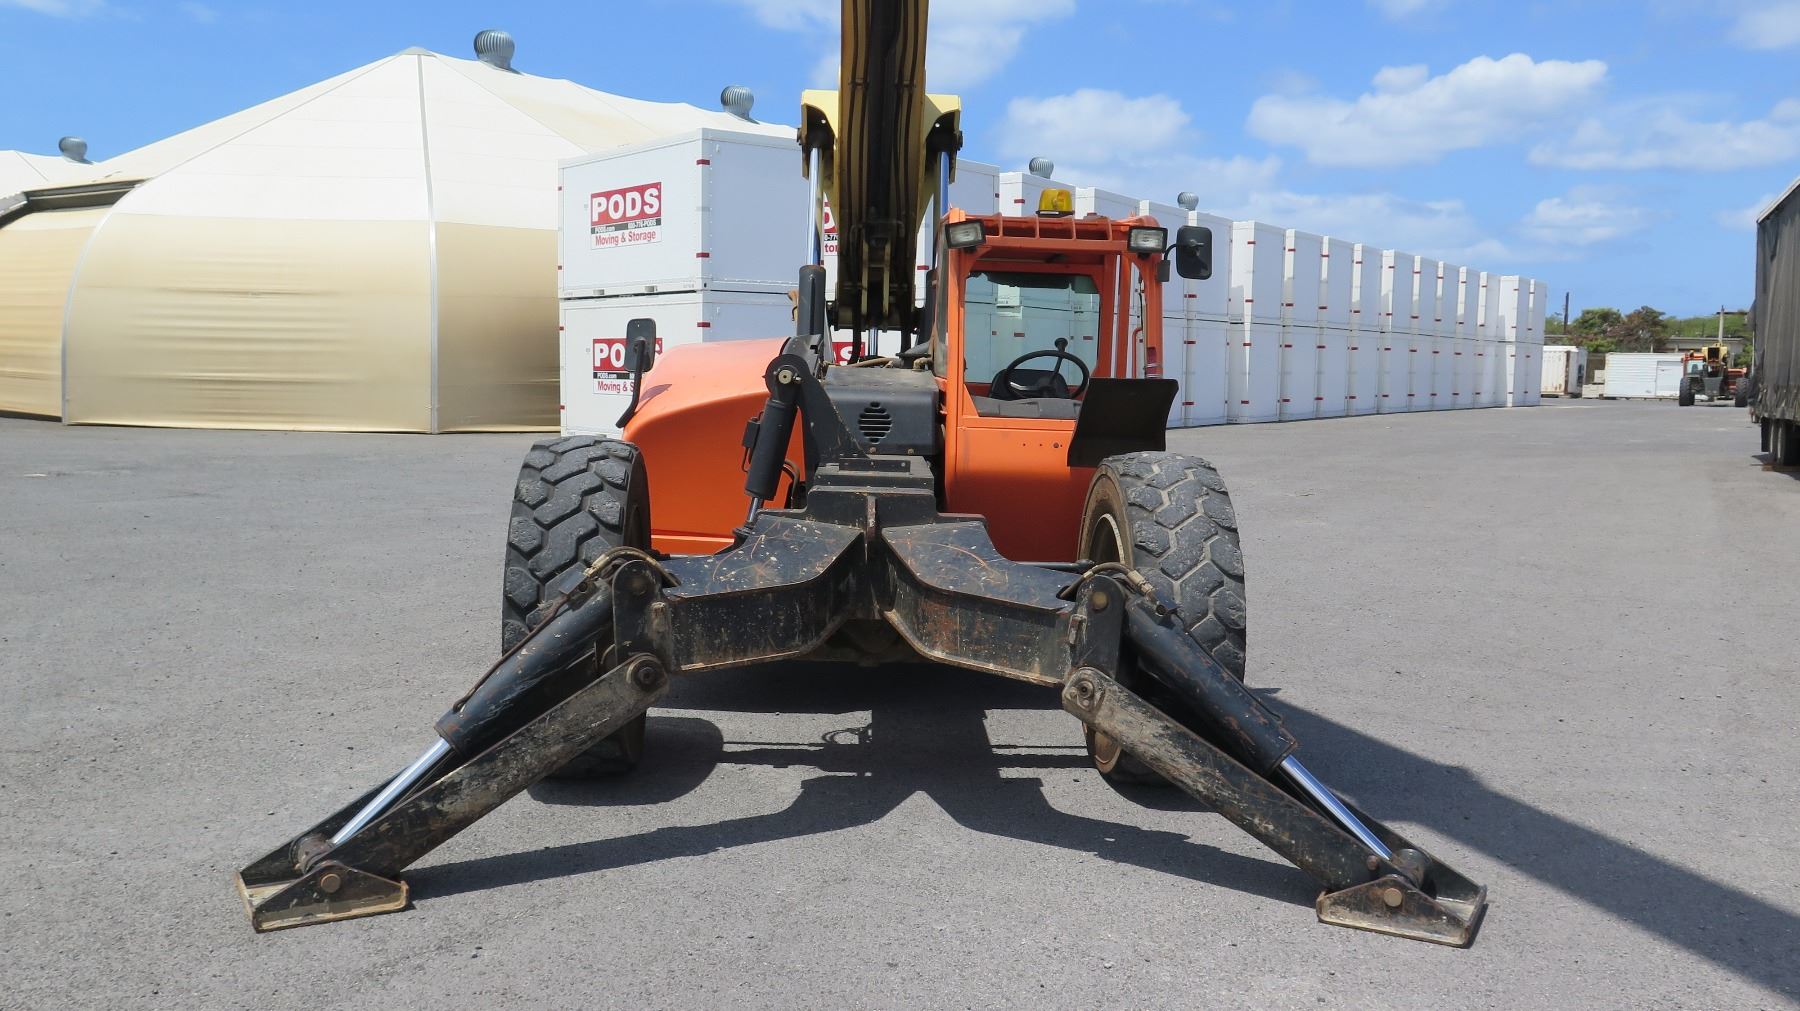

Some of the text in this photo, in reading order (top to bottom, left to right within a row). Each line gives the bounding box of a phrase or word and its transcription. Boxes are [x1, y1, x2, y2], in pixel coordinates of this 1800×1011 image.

[592, 187, 660, 222] PODS
[596, 230, 656, 246] Moving & Storage
[597, 381, 620, 393] Moving
[622, 381, 627, 391] &
